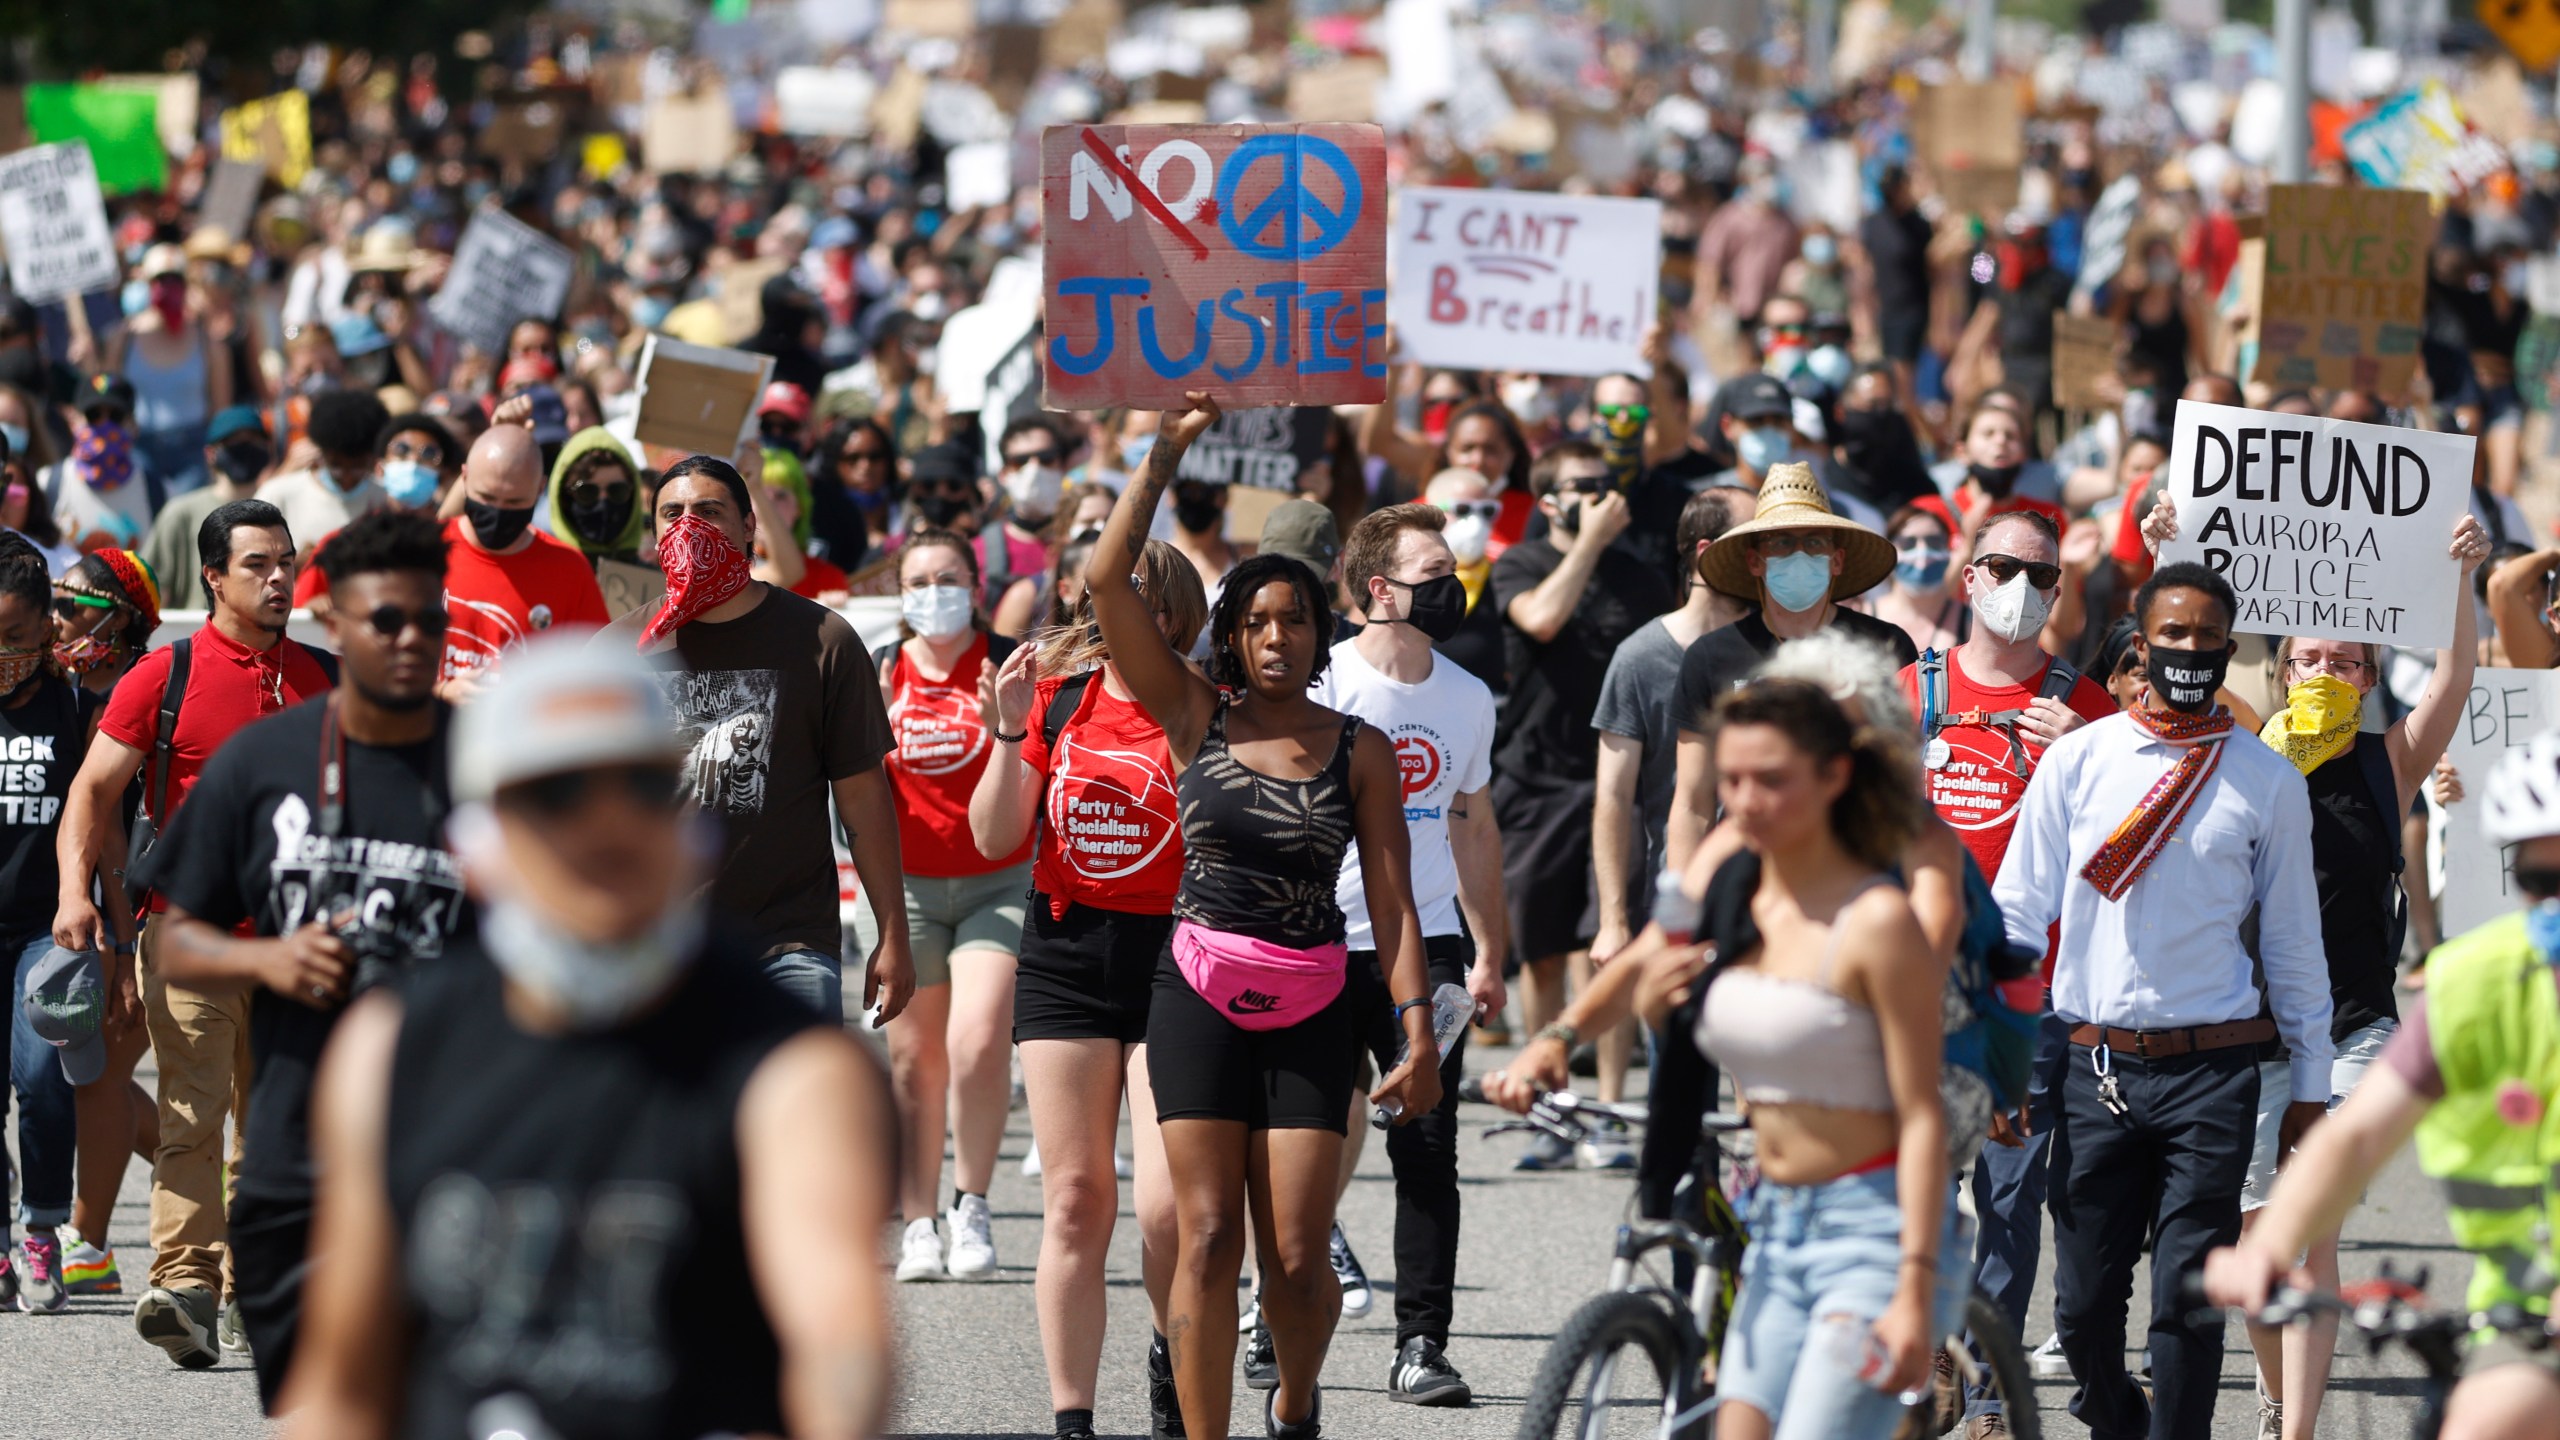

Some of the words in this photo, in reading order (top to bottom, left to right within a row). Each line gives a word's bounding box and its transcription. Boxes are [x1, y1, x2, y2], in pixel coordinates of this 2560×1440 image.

[1069, 138, 1213, 224] NO
[1412, 201, 1441, 242] I
[1458, 208, 1579, 257] CANT
[2267, 231, 2413, 277] LIVES
[1428, 264, 1645, 344] Breathe!
[2263, 277, 2420, 321] MATTER
[1050, 276, 1387, 383] JUSTICE
[1176, 445, 1299, 491] MATTER
[2192, 425, 2431, 518] DEFUND
[2197, 506, 2381, 562] AURORA
[2203, 548, 2373, 601] POLICE
[2164, 666, 2191, 684] BLACK
[2192, 669, 2214, 683] LIVES
[2170, 686, 2204, 703] MATTER
[903, 717, 936, 732] Party
[2468, 686, 2529, 747] BE
[1398, 723, 1441, 741] CENTURY
[902, 742, 964, 760] Liberation
[1401, 759, 1422, 769] 100
[1977, 763, 1989, 776] for
[1933, 773, 2000, 794] Socialism
[2001, 782, 2008, 795] &
[1068, 796, 1111, 818] Party
[1113, 802, 1127, 817] for
[1932, 789, 2002, 810] Liberation
[1067, 817, 1140, 837] Socialism
[1142, 823, 1150, 837] &
[1069, 836, 1142, 855] Liberation
[1238, 988, 1281, 1010] NIKE
